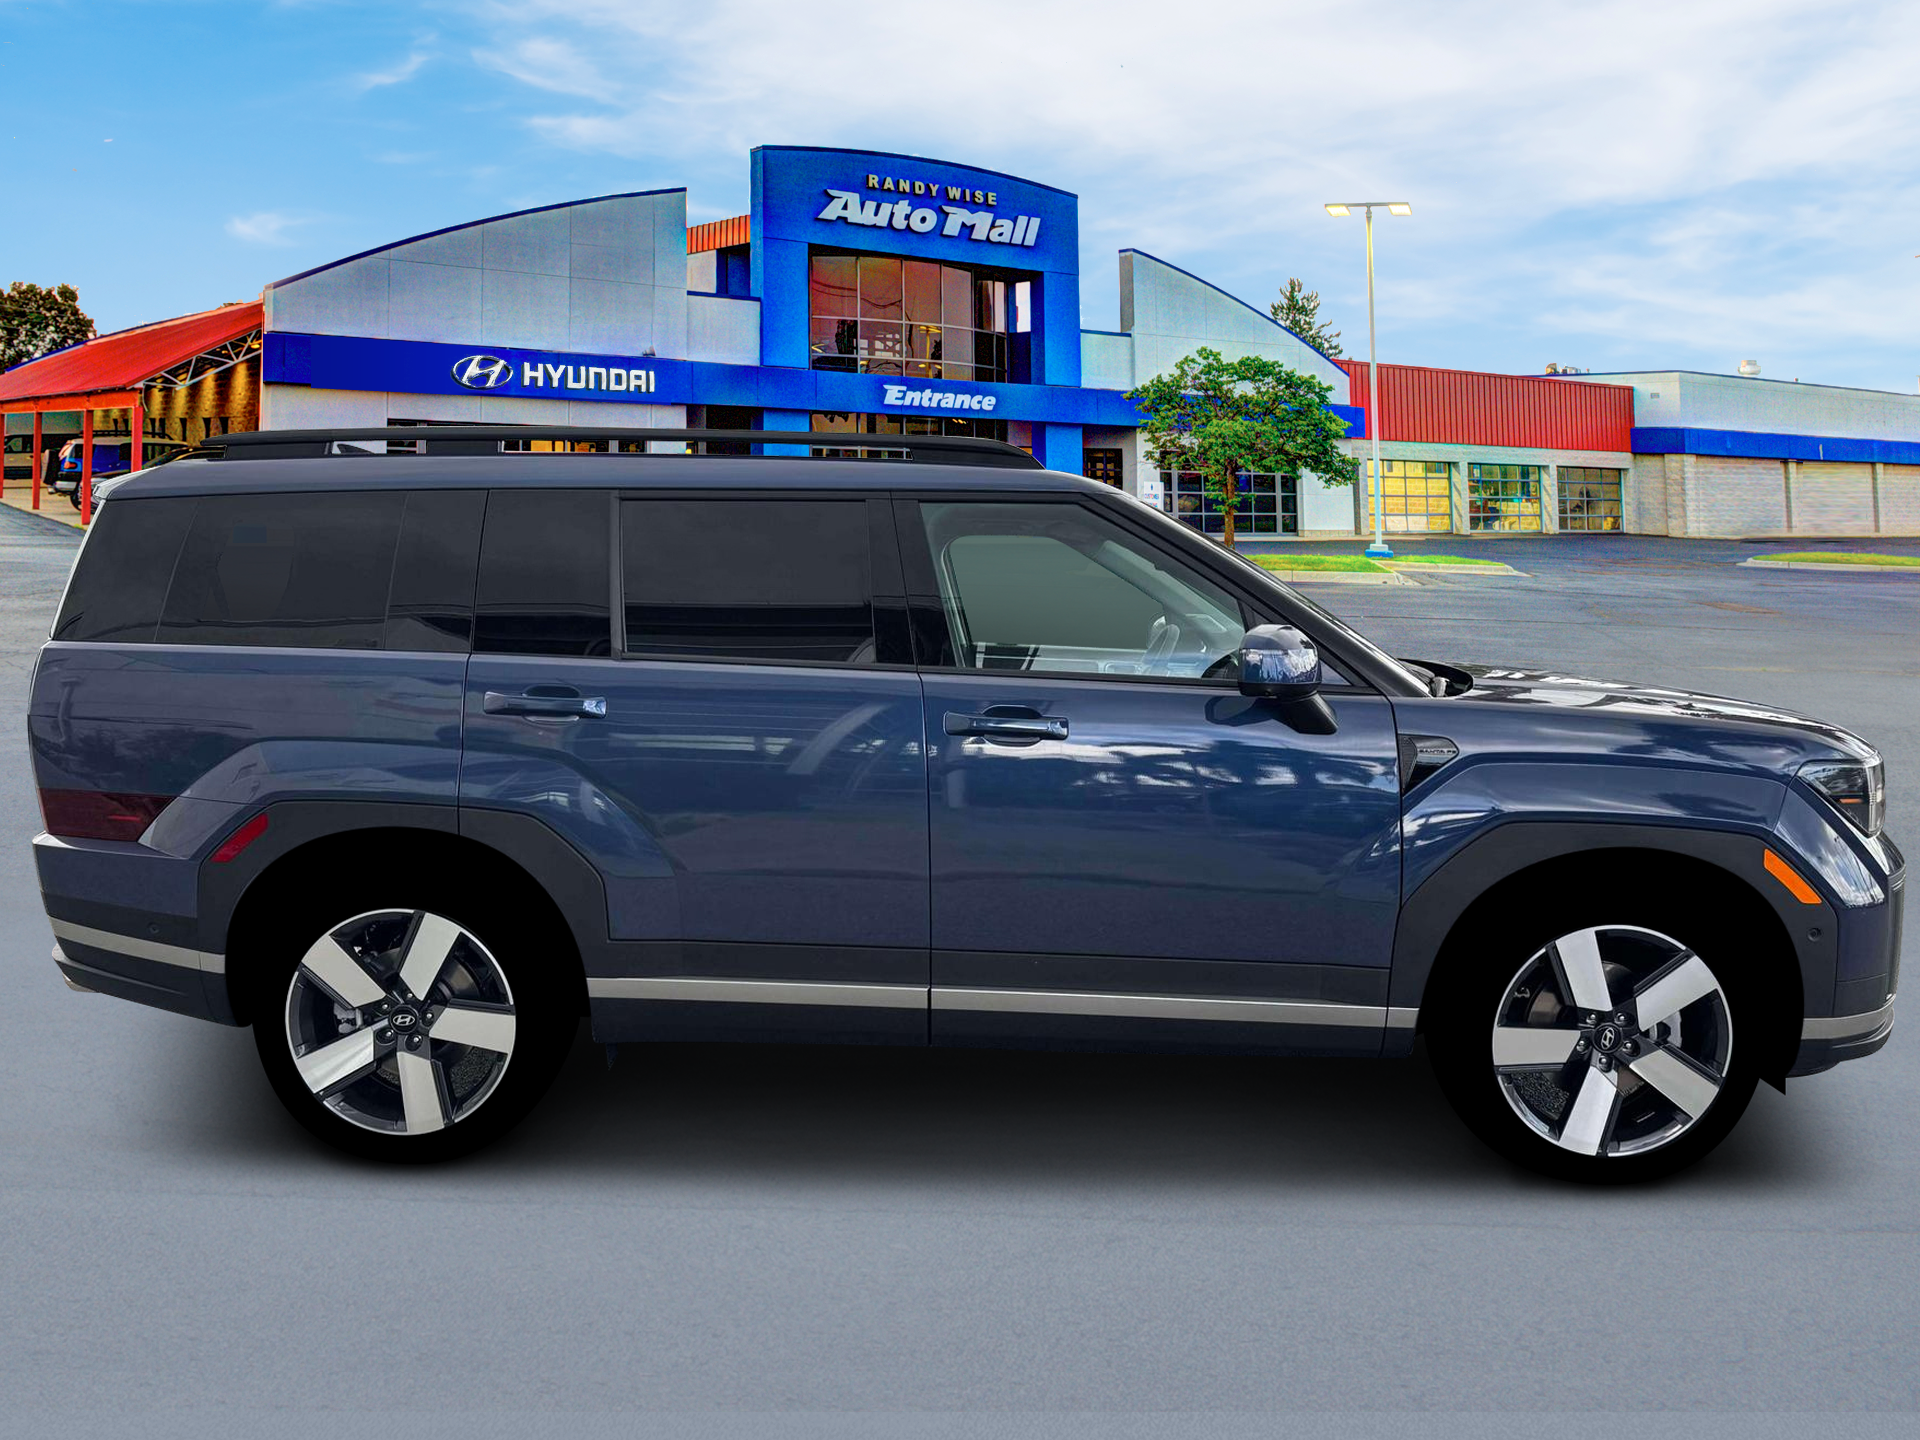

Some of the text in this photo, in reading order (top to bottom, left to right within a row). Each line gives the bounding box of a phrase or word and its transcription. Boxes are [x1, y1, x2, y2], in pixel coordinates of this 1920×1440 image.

[867, 174, 997, 205] RANDY WISE
[819, 188, 1041, 247] Auto Mall
[522, 362, 655, 393] HYUNDAI
[883, 384, 997, 411] Entrance
